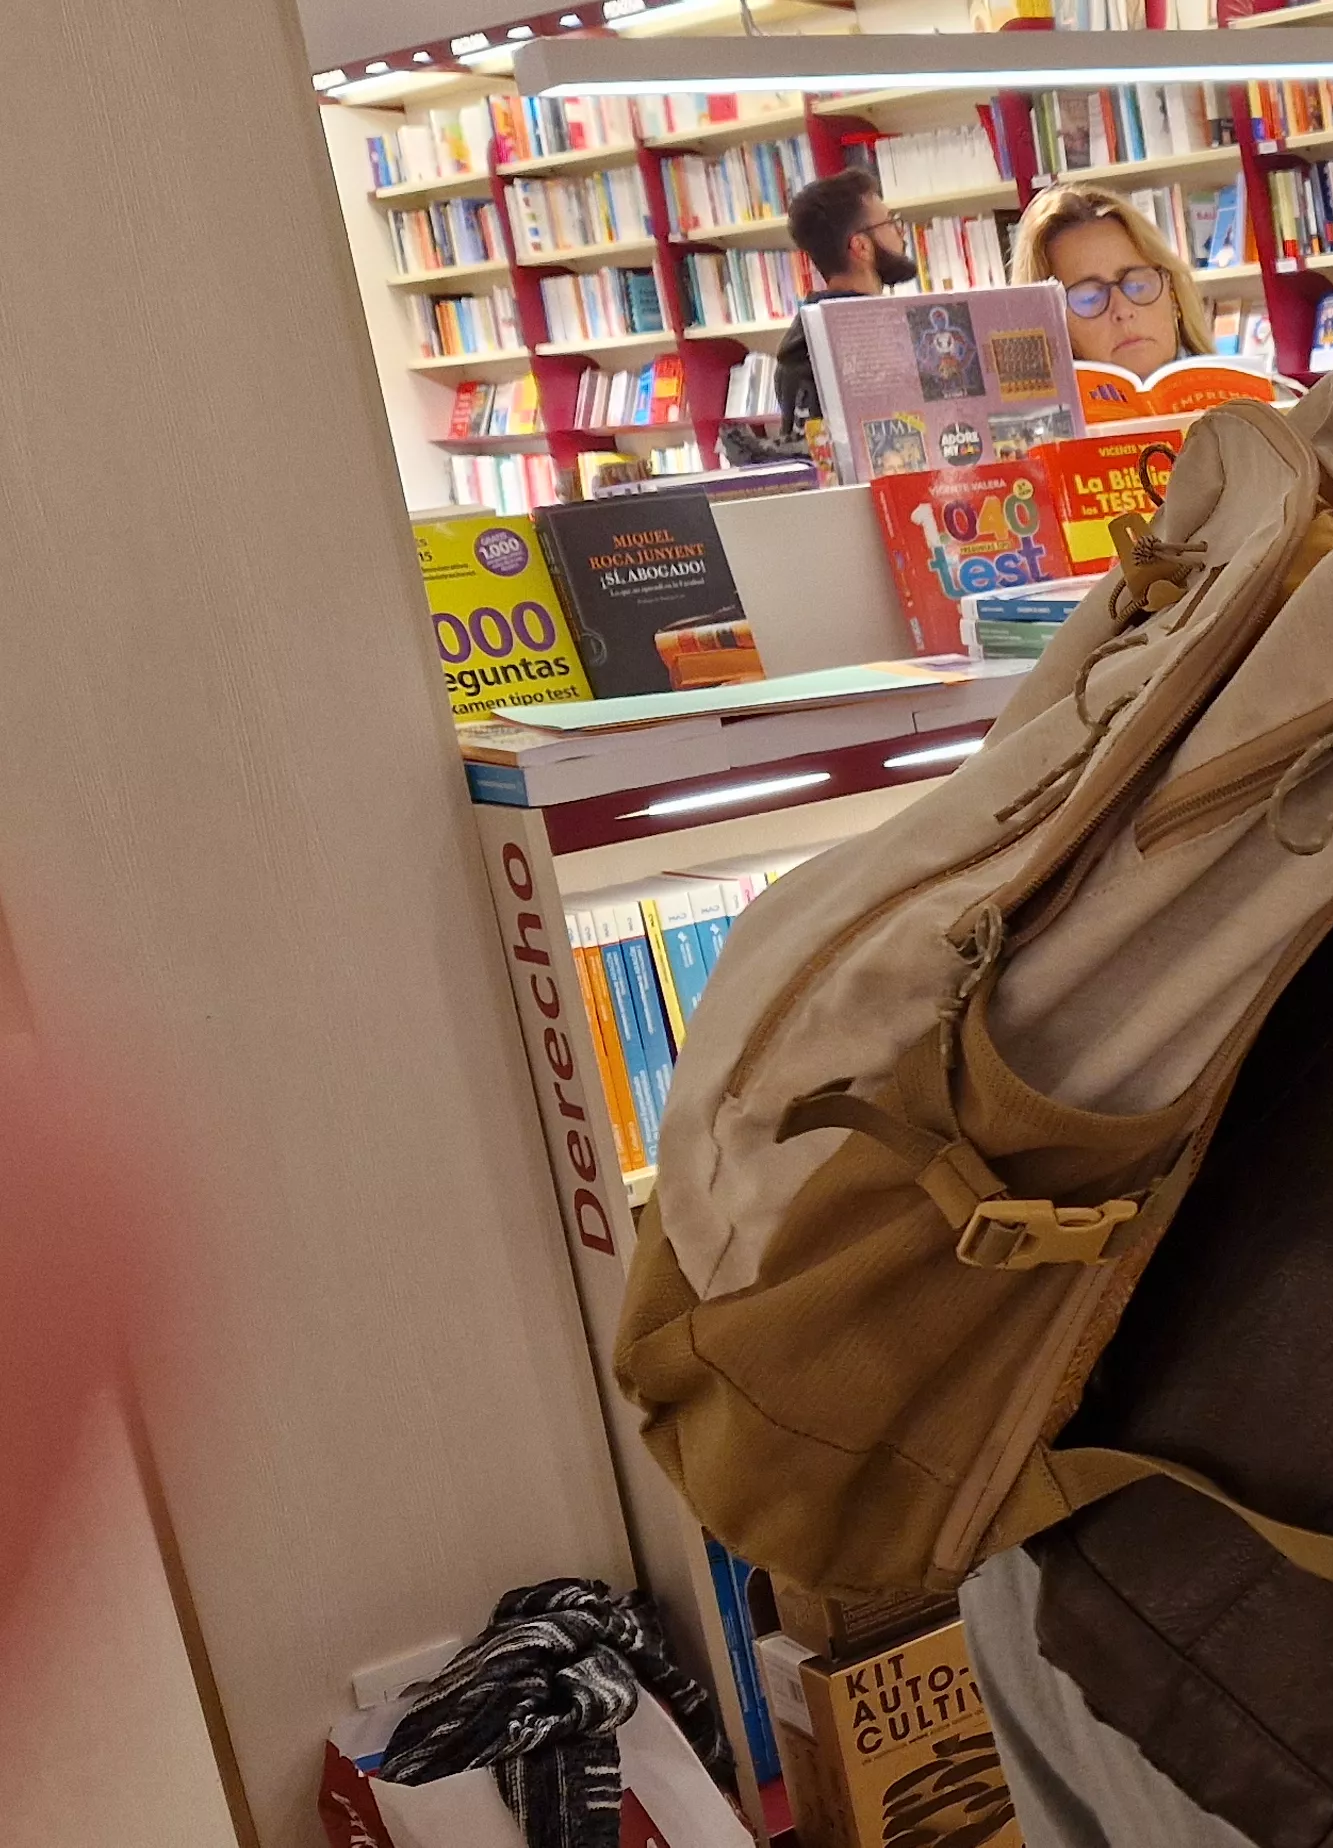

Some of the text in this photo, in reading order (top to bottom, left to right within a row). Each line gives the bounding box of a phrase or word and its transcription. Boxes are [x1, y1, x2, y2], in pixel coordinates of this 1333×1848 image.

[941, 431, 980, 446] ADORE
[1074, 464, 1171, 494] La Bibia
[588, 543, 705, 570] ROCA JUNYENT
[612, 528, 675, 550] MIQUEL
[928, 535, 1052, 599] test
[444, 656, 571, 697] eguntas
[508, 690, 545, 716] tipo
[545, 684, 581, 706] test
[502, 842, 616, 1257] Derecho
[845, 1653, 904, 1701] KIT
[852, 1664, 969, 1729] AUTO-
